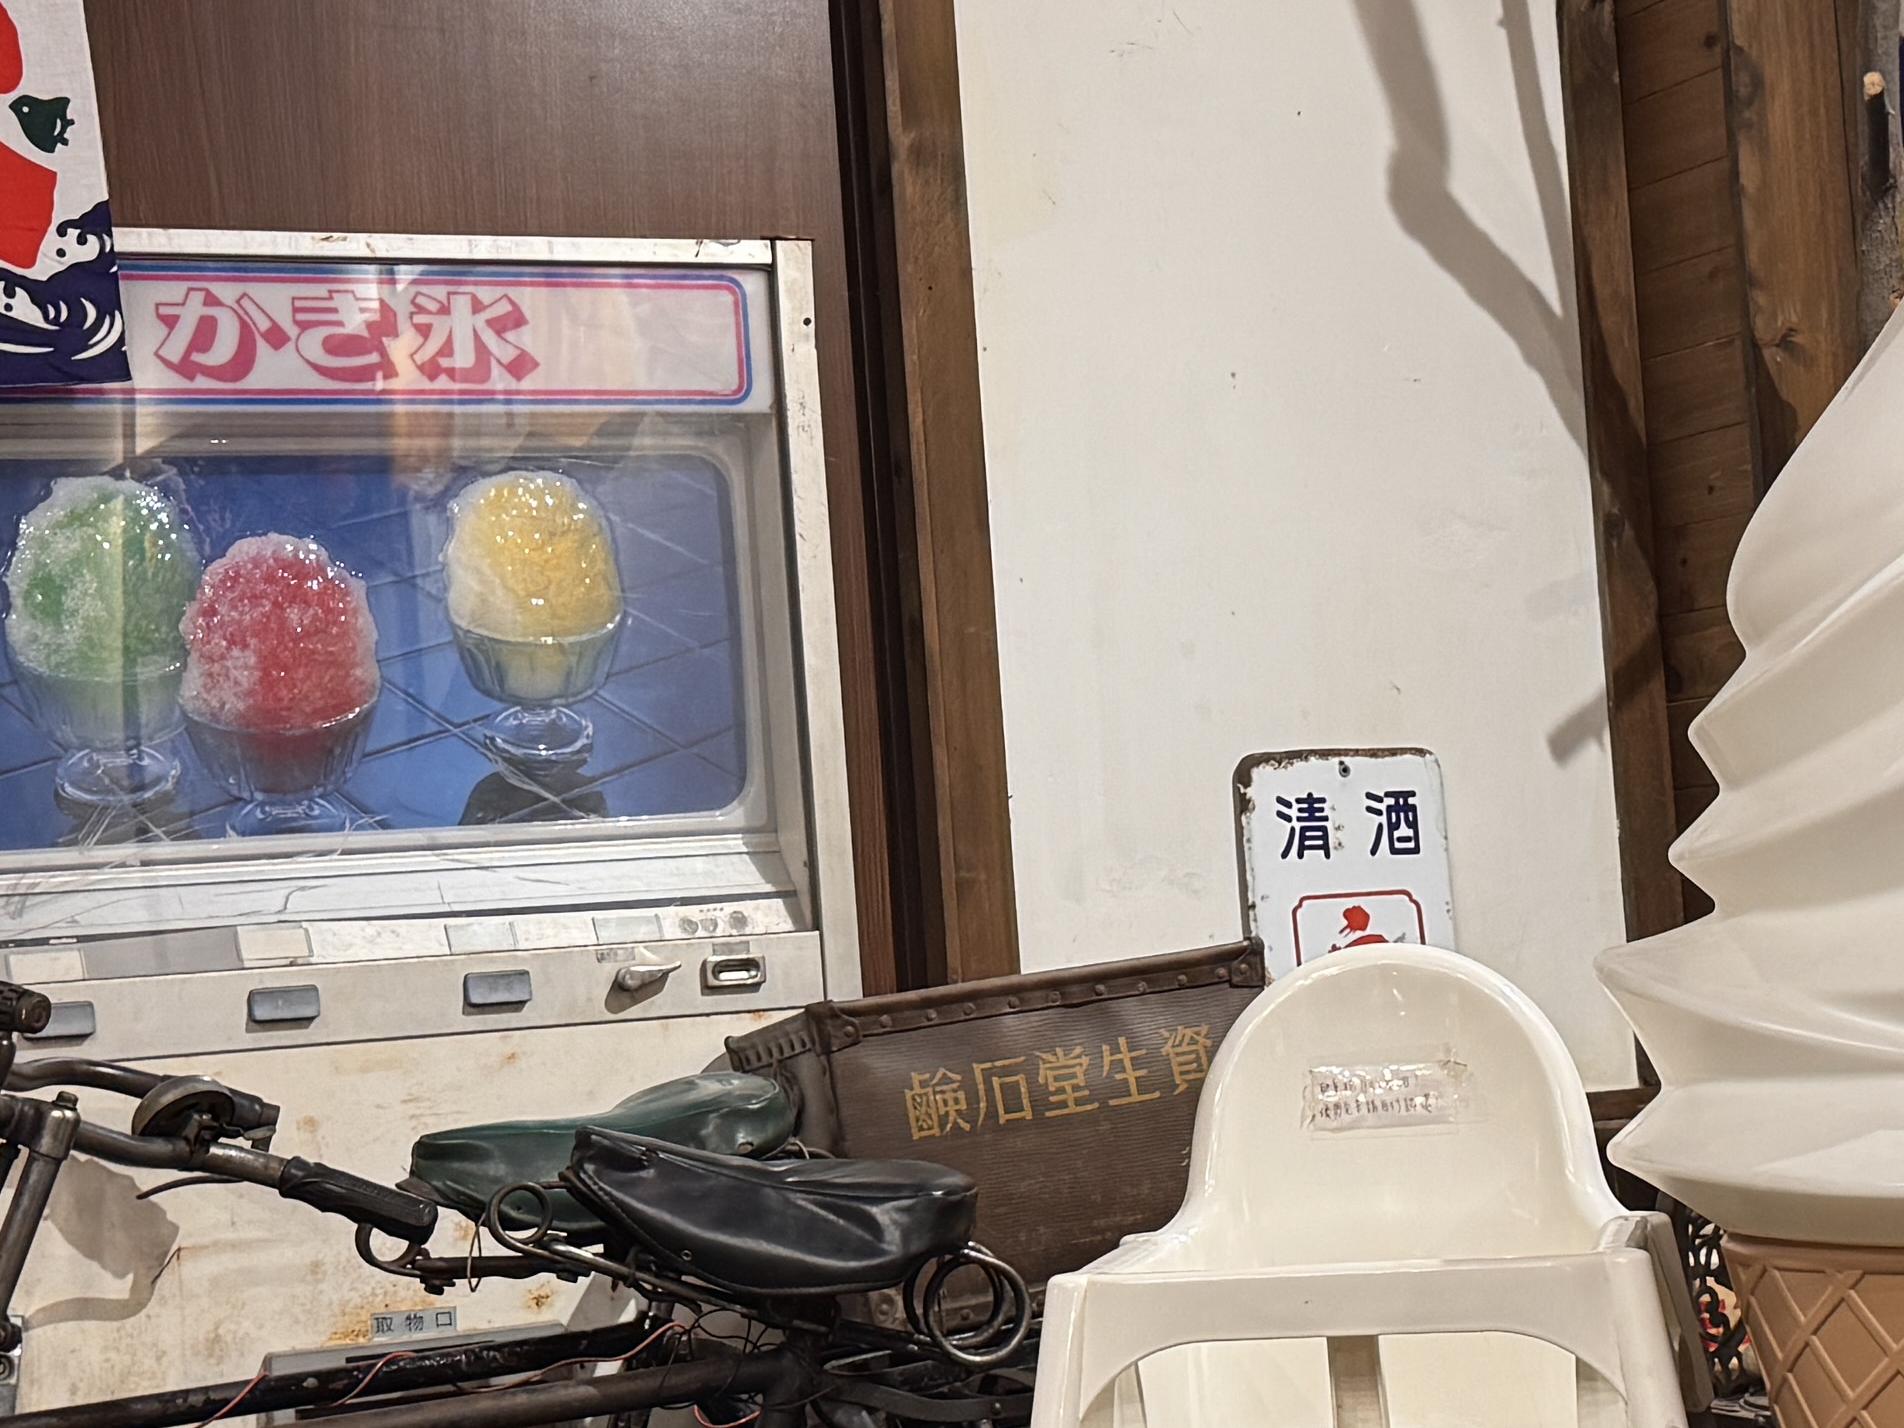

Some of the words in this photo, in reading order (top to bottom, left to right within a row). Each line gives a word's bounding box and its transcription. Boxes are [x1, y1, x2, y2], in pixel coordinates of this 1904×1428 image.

[154, 286, 541, 384] かき氷
[1276, 790, 1421, 860] 清酒
